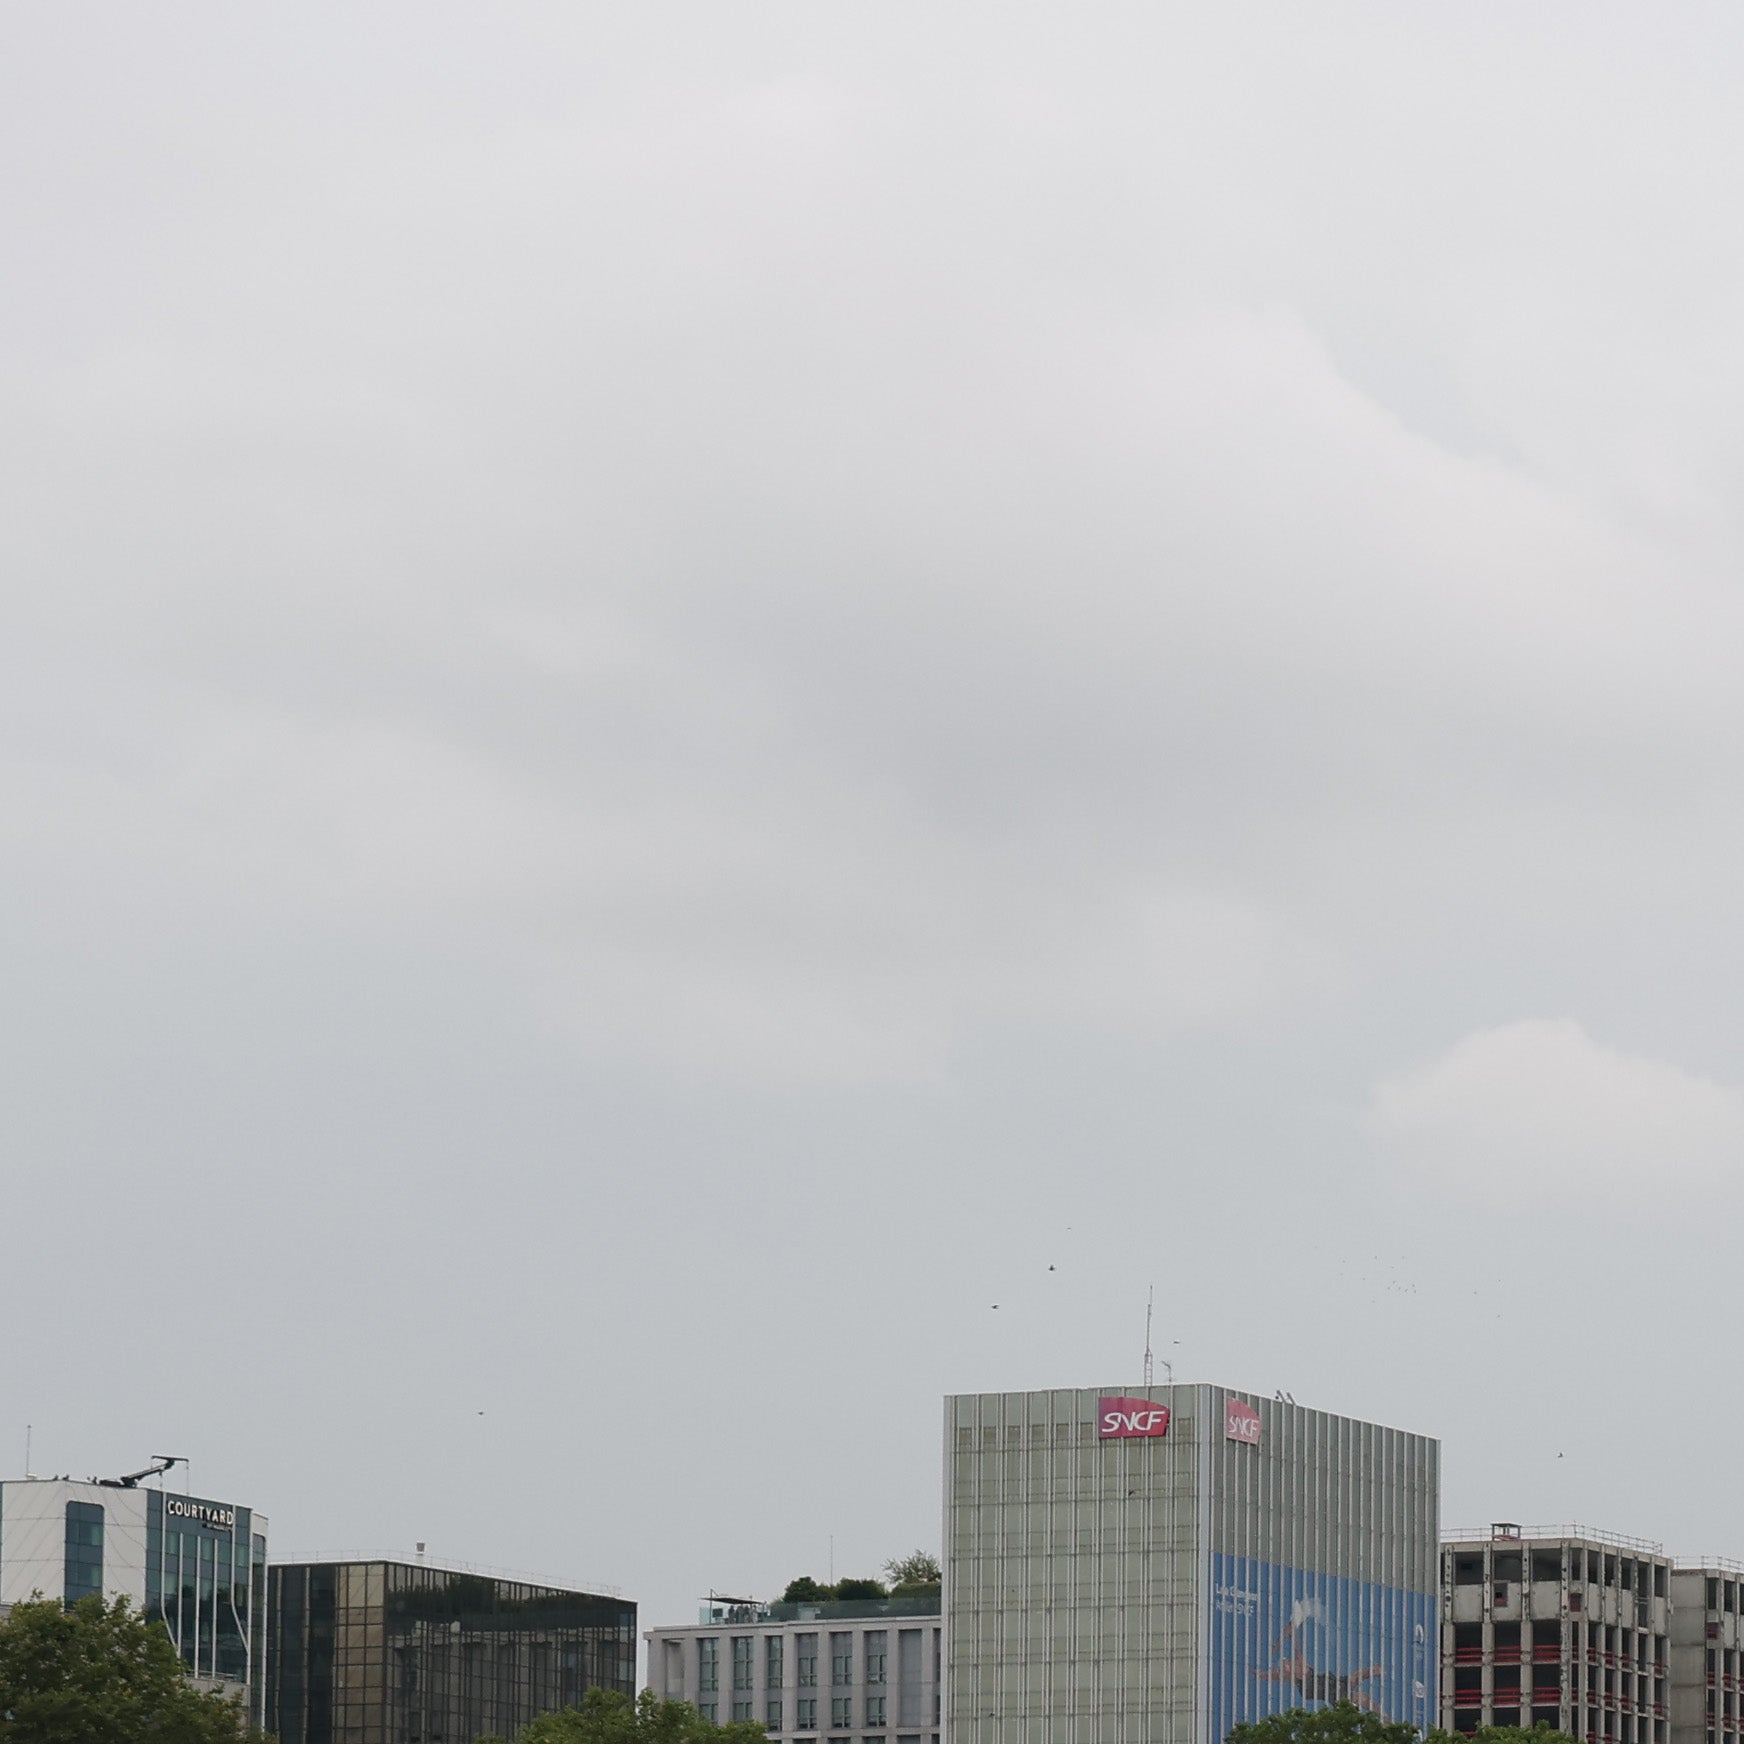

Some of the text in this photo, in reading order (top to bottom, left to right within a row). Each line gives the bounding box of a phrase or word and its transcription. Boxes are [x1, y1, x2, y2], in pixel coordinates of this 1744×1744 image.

[1101, 1410, 1166, 1433] SNCF
[1229, 1415, 1260, 1437] SNCF
[167, 1500, 234, 1525] COURTYARD
